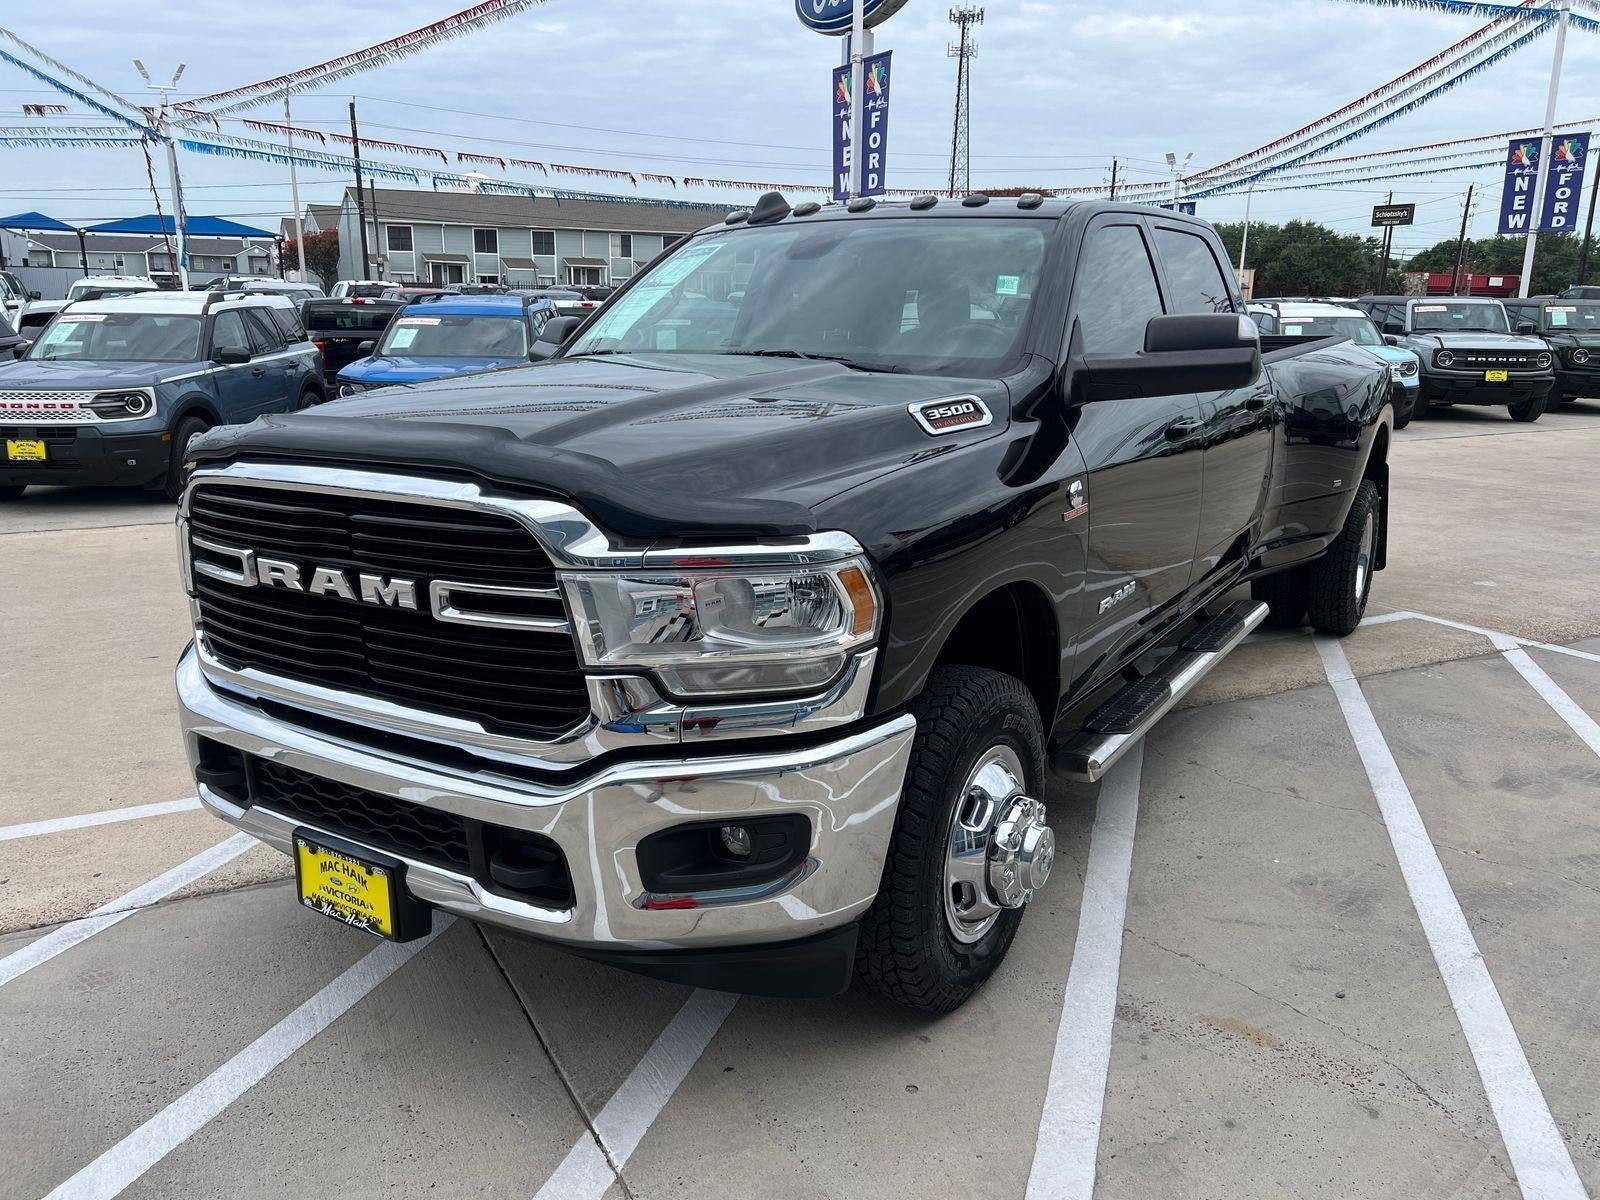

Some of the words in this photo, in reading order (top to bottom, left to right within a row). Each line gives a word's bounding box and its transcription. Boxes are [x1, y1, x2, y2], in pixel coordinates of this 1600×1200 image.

[868, 111, 881, 190] FORD
[1508, 176, 1530, 229] NEW
[1551, 173, 1573, 228] FORD
[925, 402, 975, 420] 3500
[257, 557, 418, 611] RAM
[320, 860, 341, 874] MAC
[342, 863, 369, 891] HAIK
[320, 903, 344, 920] Mac
